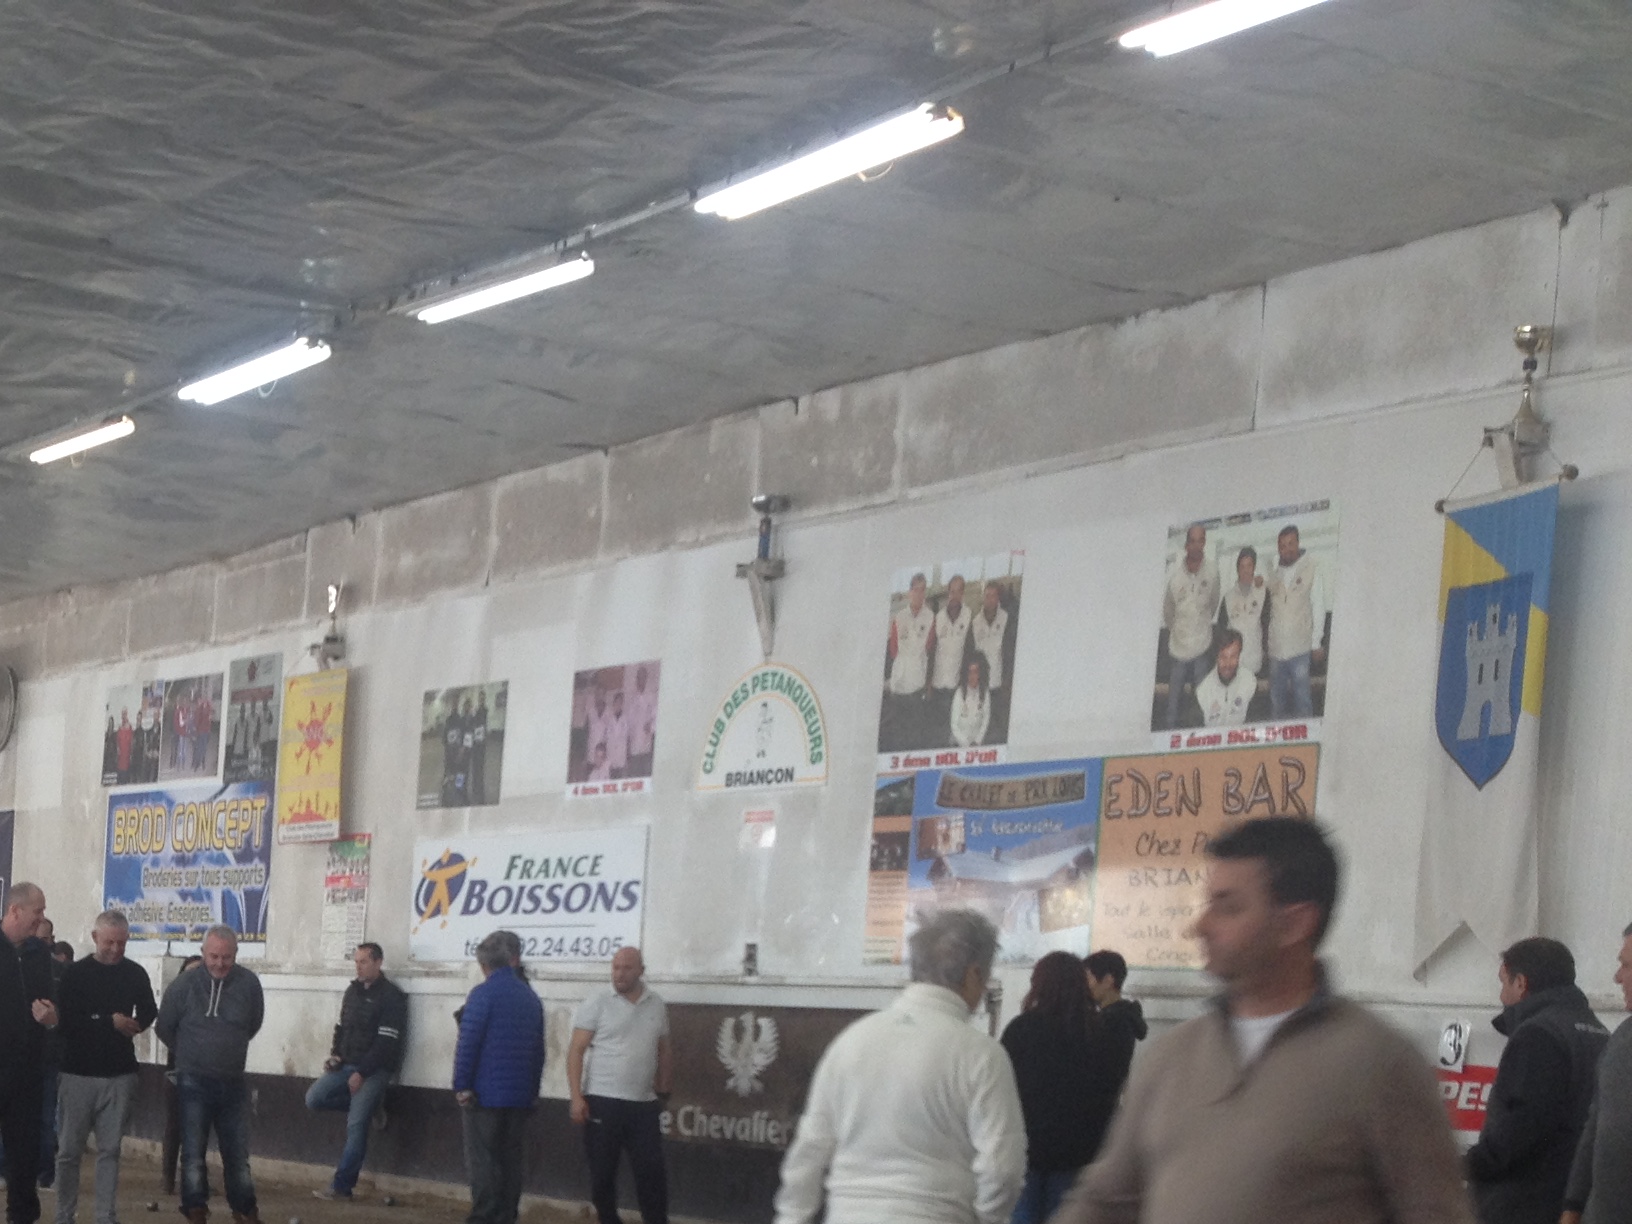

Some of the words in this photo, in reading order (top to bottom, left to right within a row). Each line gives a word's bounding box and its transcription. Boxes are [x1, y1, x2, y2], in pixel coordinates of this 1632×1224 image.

[703, 718, 726, 775] CLUB
[723, 683, 750, 719] DES
[751, 671, 823, 765] PETANQUEURS
[1170, 734, 1181, 749] 2
[1228, 728, 1259, 744] BOL
[890, 757, 899, 768] 3
[1104, 767, 1202, 820] EDEN
[1222, 757, 1308, 816] BAR
[112, 805, 167, 854] BROD
[171, 798, 266, 852] CONCEPT
[1135, 830, 1181, 857] Chez
[143, 867, 182, 888] Broderies
[184, 871, 199, 886] sur
[201, 866, 221, 886] tous
[223, 865, 263, 890] supports
